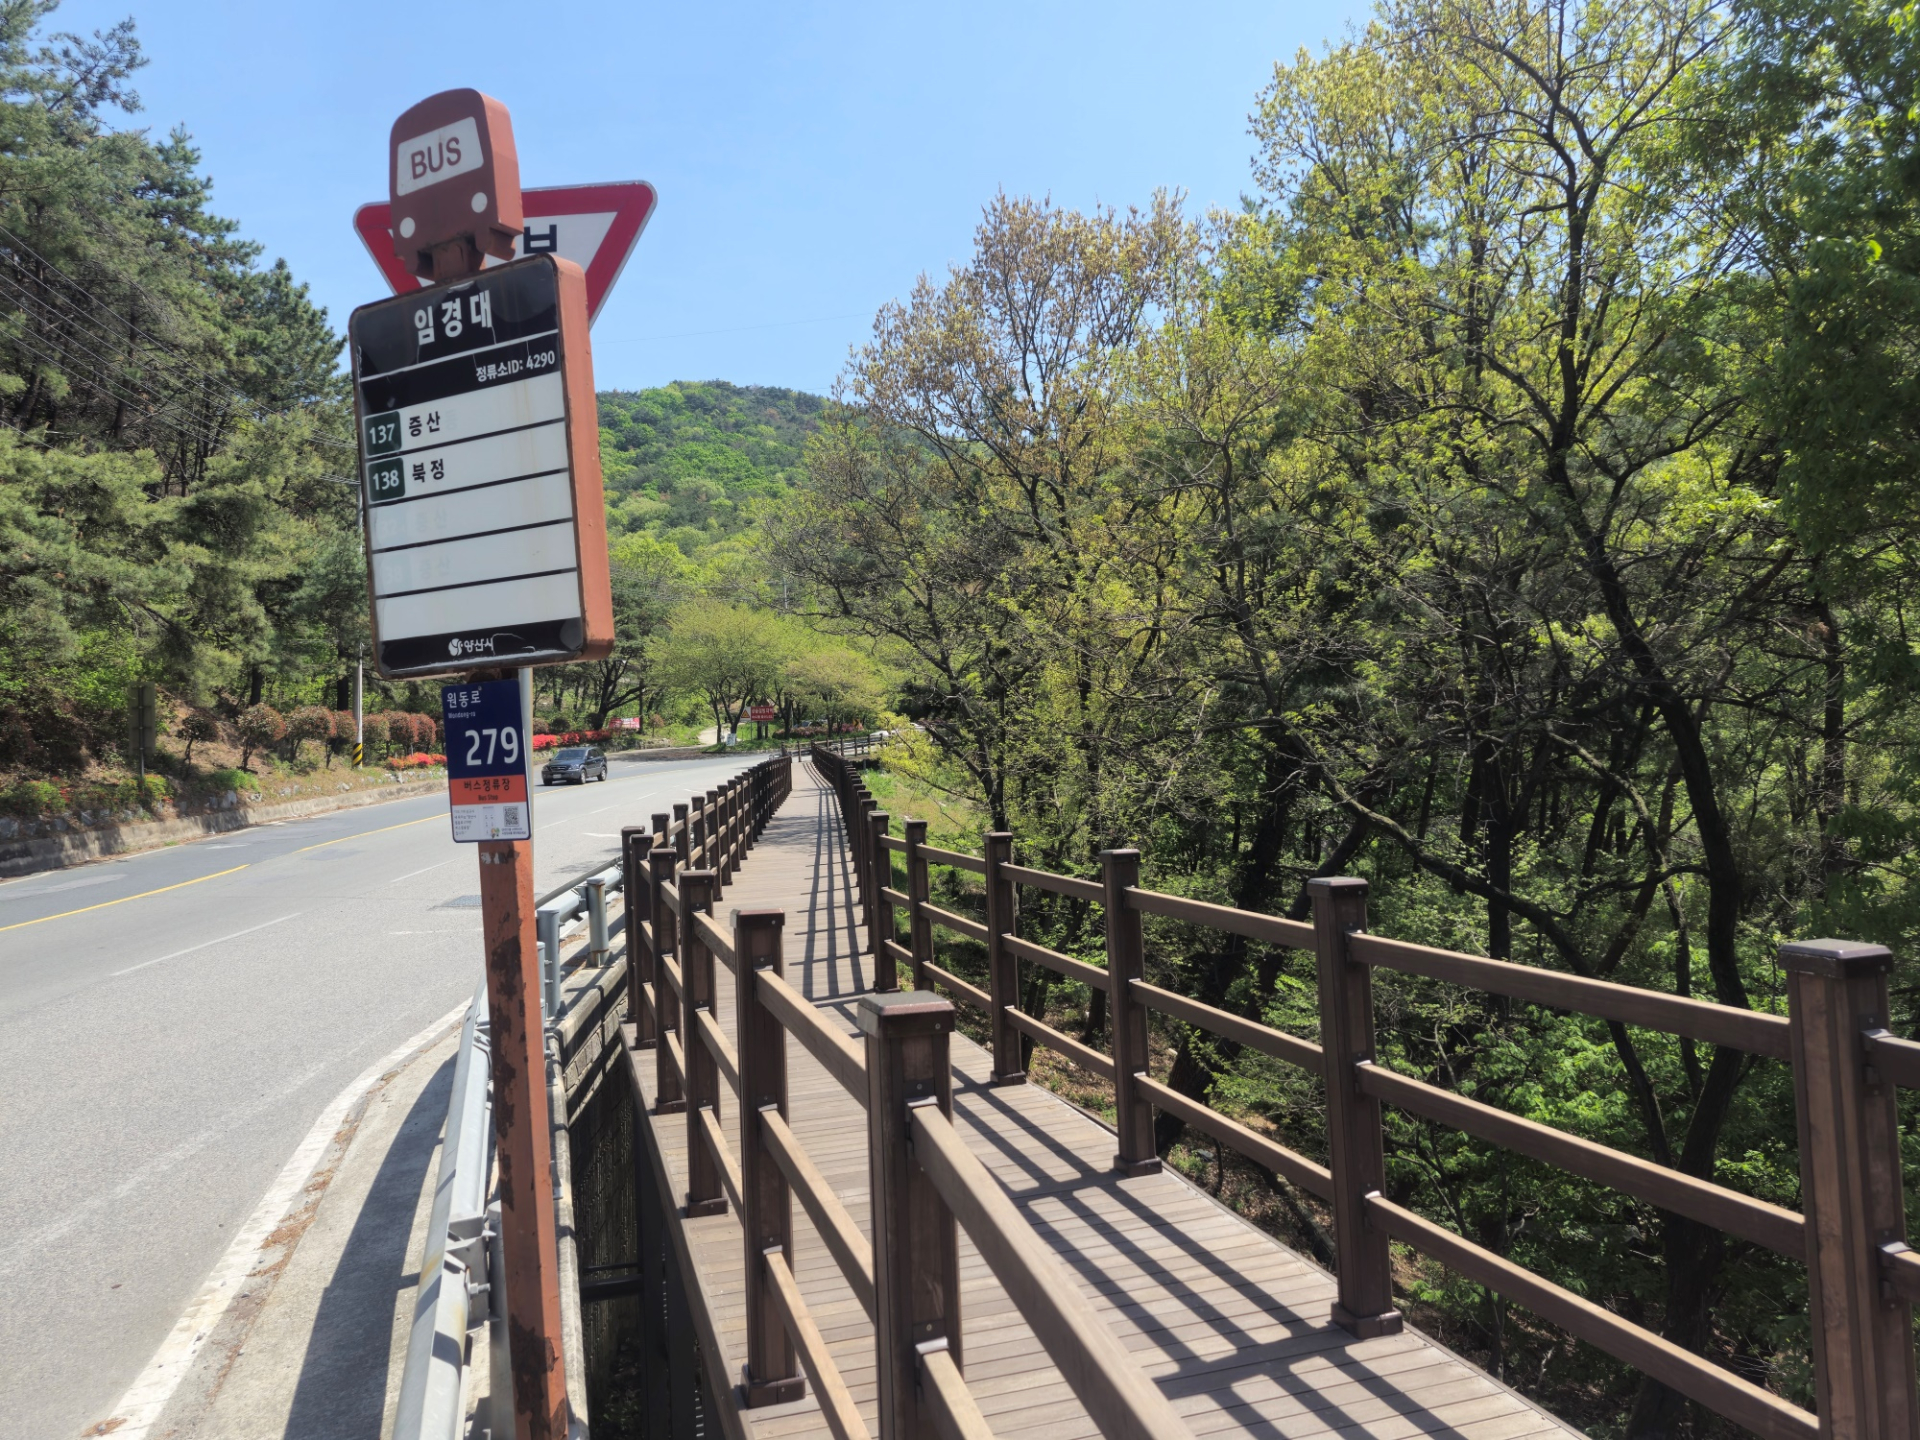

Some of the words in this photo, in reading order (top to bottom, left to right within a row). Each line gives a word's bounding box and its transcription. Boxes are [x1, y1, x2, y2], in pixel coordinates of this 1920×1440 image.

[411, 136, 462, 180] BUS
[414, 290, 493, 345] 임경대
[476, 360, 523, 382] 정류소ID:
[526, 350, 556, 370] 4290
[369, 423, 395, 444] 137
[409, 411, 441, 437] 증산
[372, 469, 400, 490] 138
[412, 458, 444, 483] 북정
[463, 638, 494, 653] 양산시
[447, 690, 481, 708] 원동로
[465, 726, 519, 766] 279
[464, 778, 510, 792] 버스정류장
